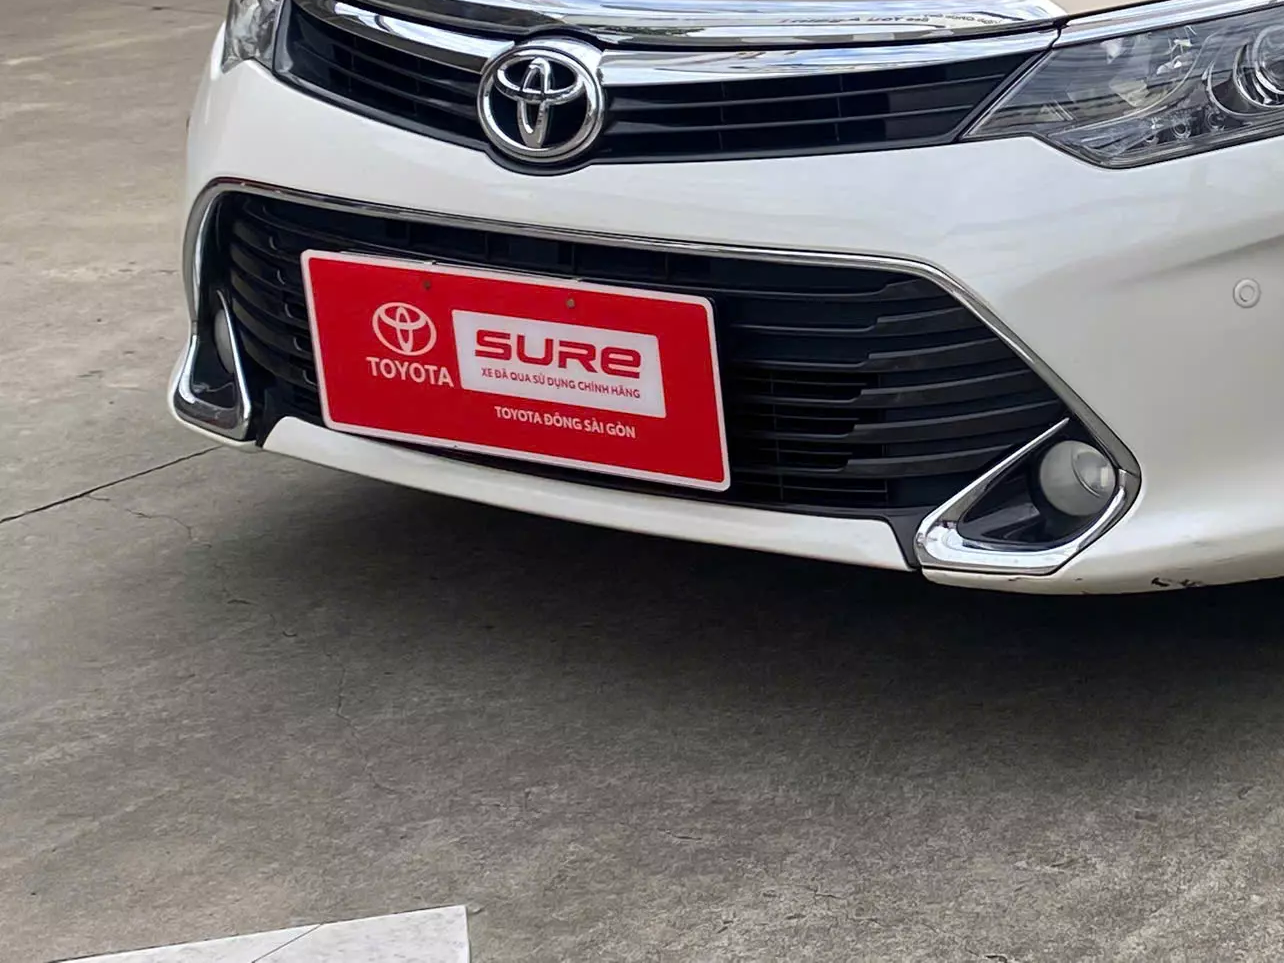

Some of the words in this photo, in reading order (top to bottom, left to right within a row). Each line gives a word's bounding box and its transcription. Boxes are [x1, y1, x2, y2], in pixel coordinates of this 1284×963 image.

[366, 356, 454, 388] TOYOTA
[481, 367, 494, 378] XE
[494, 367, 509, 380] ĐÃ
[511, 371, 531, 384] QUA
[532, 369, 546, 385] SỬ
[547, 375, 576, 390] DỤNG
[578, 378, 609, 395] CHÍNH
[611, 382, 641, 399] HÃNG
[494, 405, 543, 425] TOYOTA
[544, 411, 582, 431] ĐÔNG
[584, 415, 604, 434] SÀI
[606, 418, 636, 439] GÒN
